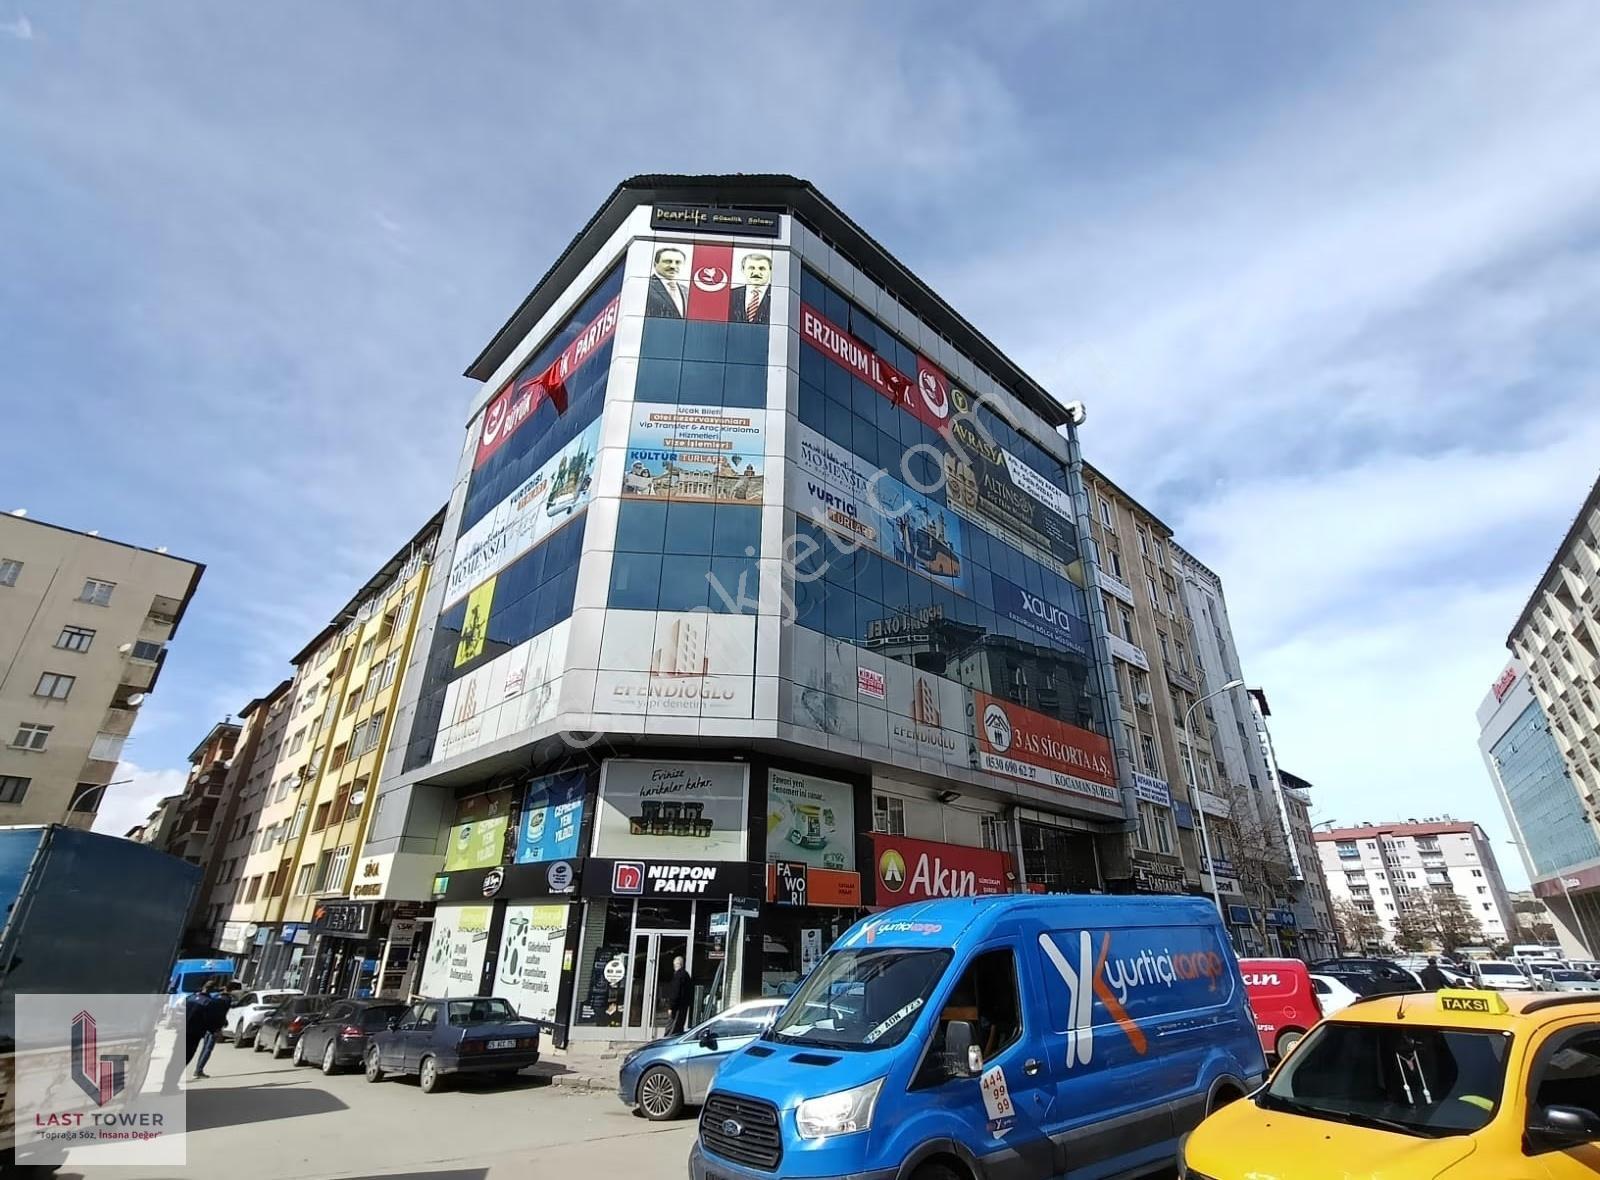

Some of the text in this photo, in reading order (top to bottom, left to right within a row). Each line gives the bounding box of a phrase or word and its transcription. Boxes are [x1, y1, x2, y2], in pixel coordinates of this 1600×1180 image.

[804, 311, 869, 376] ERZURUM
[1041, 735, 1088, 770] SİGORTA
[648, 865, 717, 880] NIPPON
[909, 852, 977, 898] Akın
[654, 879, 709, 893] PAINT
[983, 1070, 1003, 1091] 444
[993, 1085, 1005, 1100] 99
[997, 1098, 1010, 1114] 99
